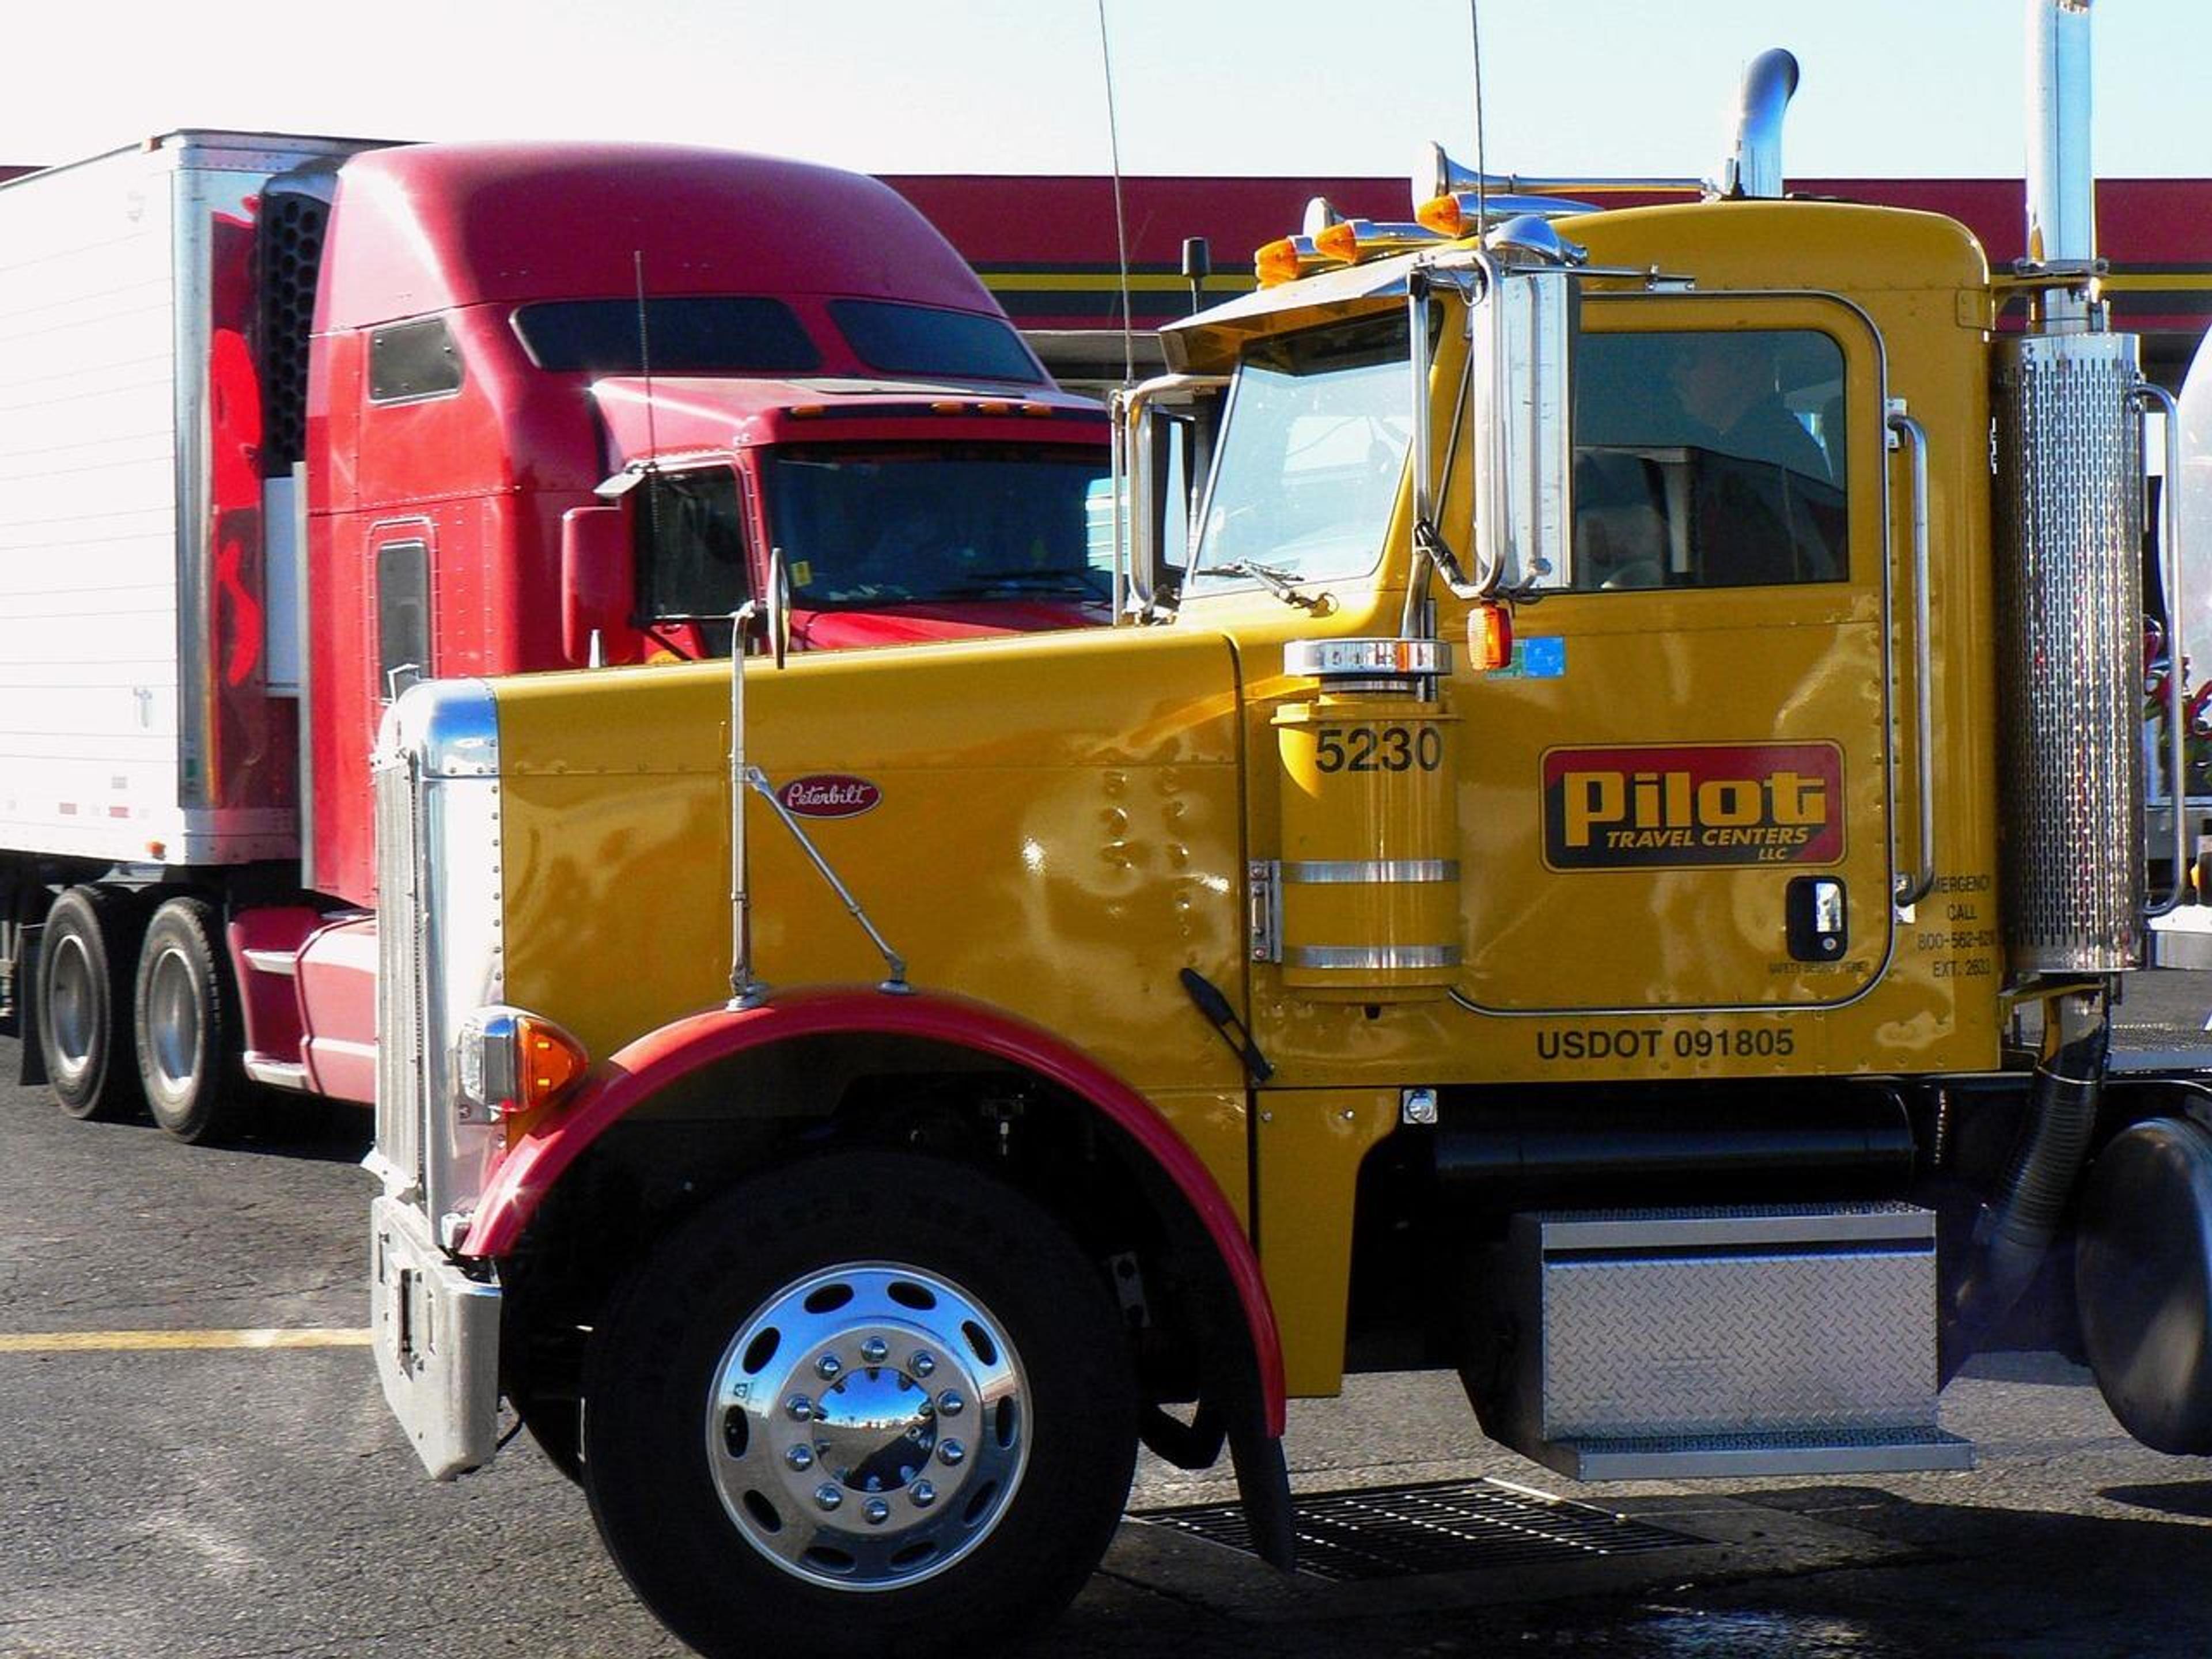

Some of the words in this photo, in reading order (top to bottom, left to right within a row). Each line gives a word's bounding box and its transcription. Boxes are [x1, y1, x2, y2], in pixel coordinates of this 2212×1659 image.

[1315, 726, 1441, 773] 5230
[786, 782, 872, 807] Peterbilt
[1564, 771, 1826, 847] Pilot
[1605, 830, 1694, 848] TRAVEL
[1701, 827, 1809, 846] CENTERS
[1757, 847, 1786, 861] LLC
[1948, 903, 1978, 922] CALL
[1537, 1030, 1662, 1059] USDOT
[1674, 1029, 1794, 1058] 091805
